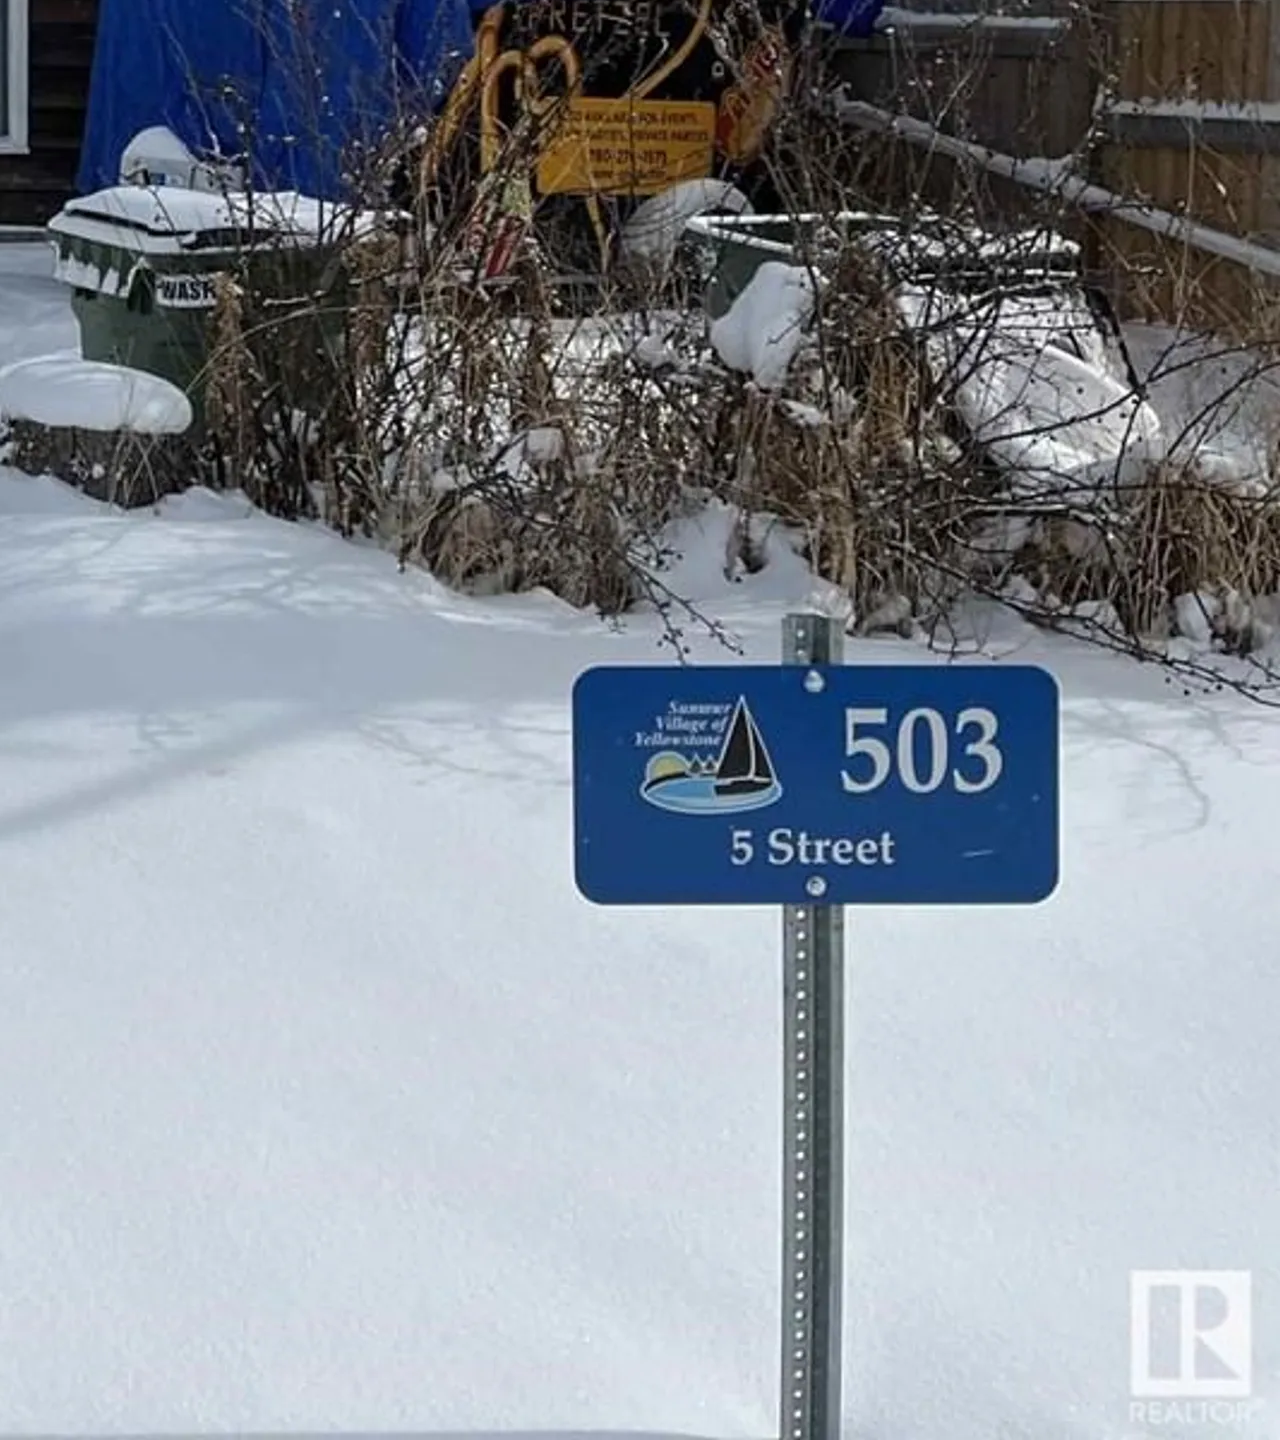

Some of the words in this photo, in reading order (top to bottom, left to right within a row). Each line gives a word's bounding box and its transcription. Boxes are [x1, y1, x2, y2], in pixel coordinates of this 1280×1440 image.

[668, 700, 732, 715] Summer
[655, 715, 708, 732] Village
[711, 714, 731, 732] of
[634, 731, 722, 747] Yellowstone
[841, 706, 1003, 795] 503
[730, 829, 754, 866] 5
[768, 827, 895, 866] Street
